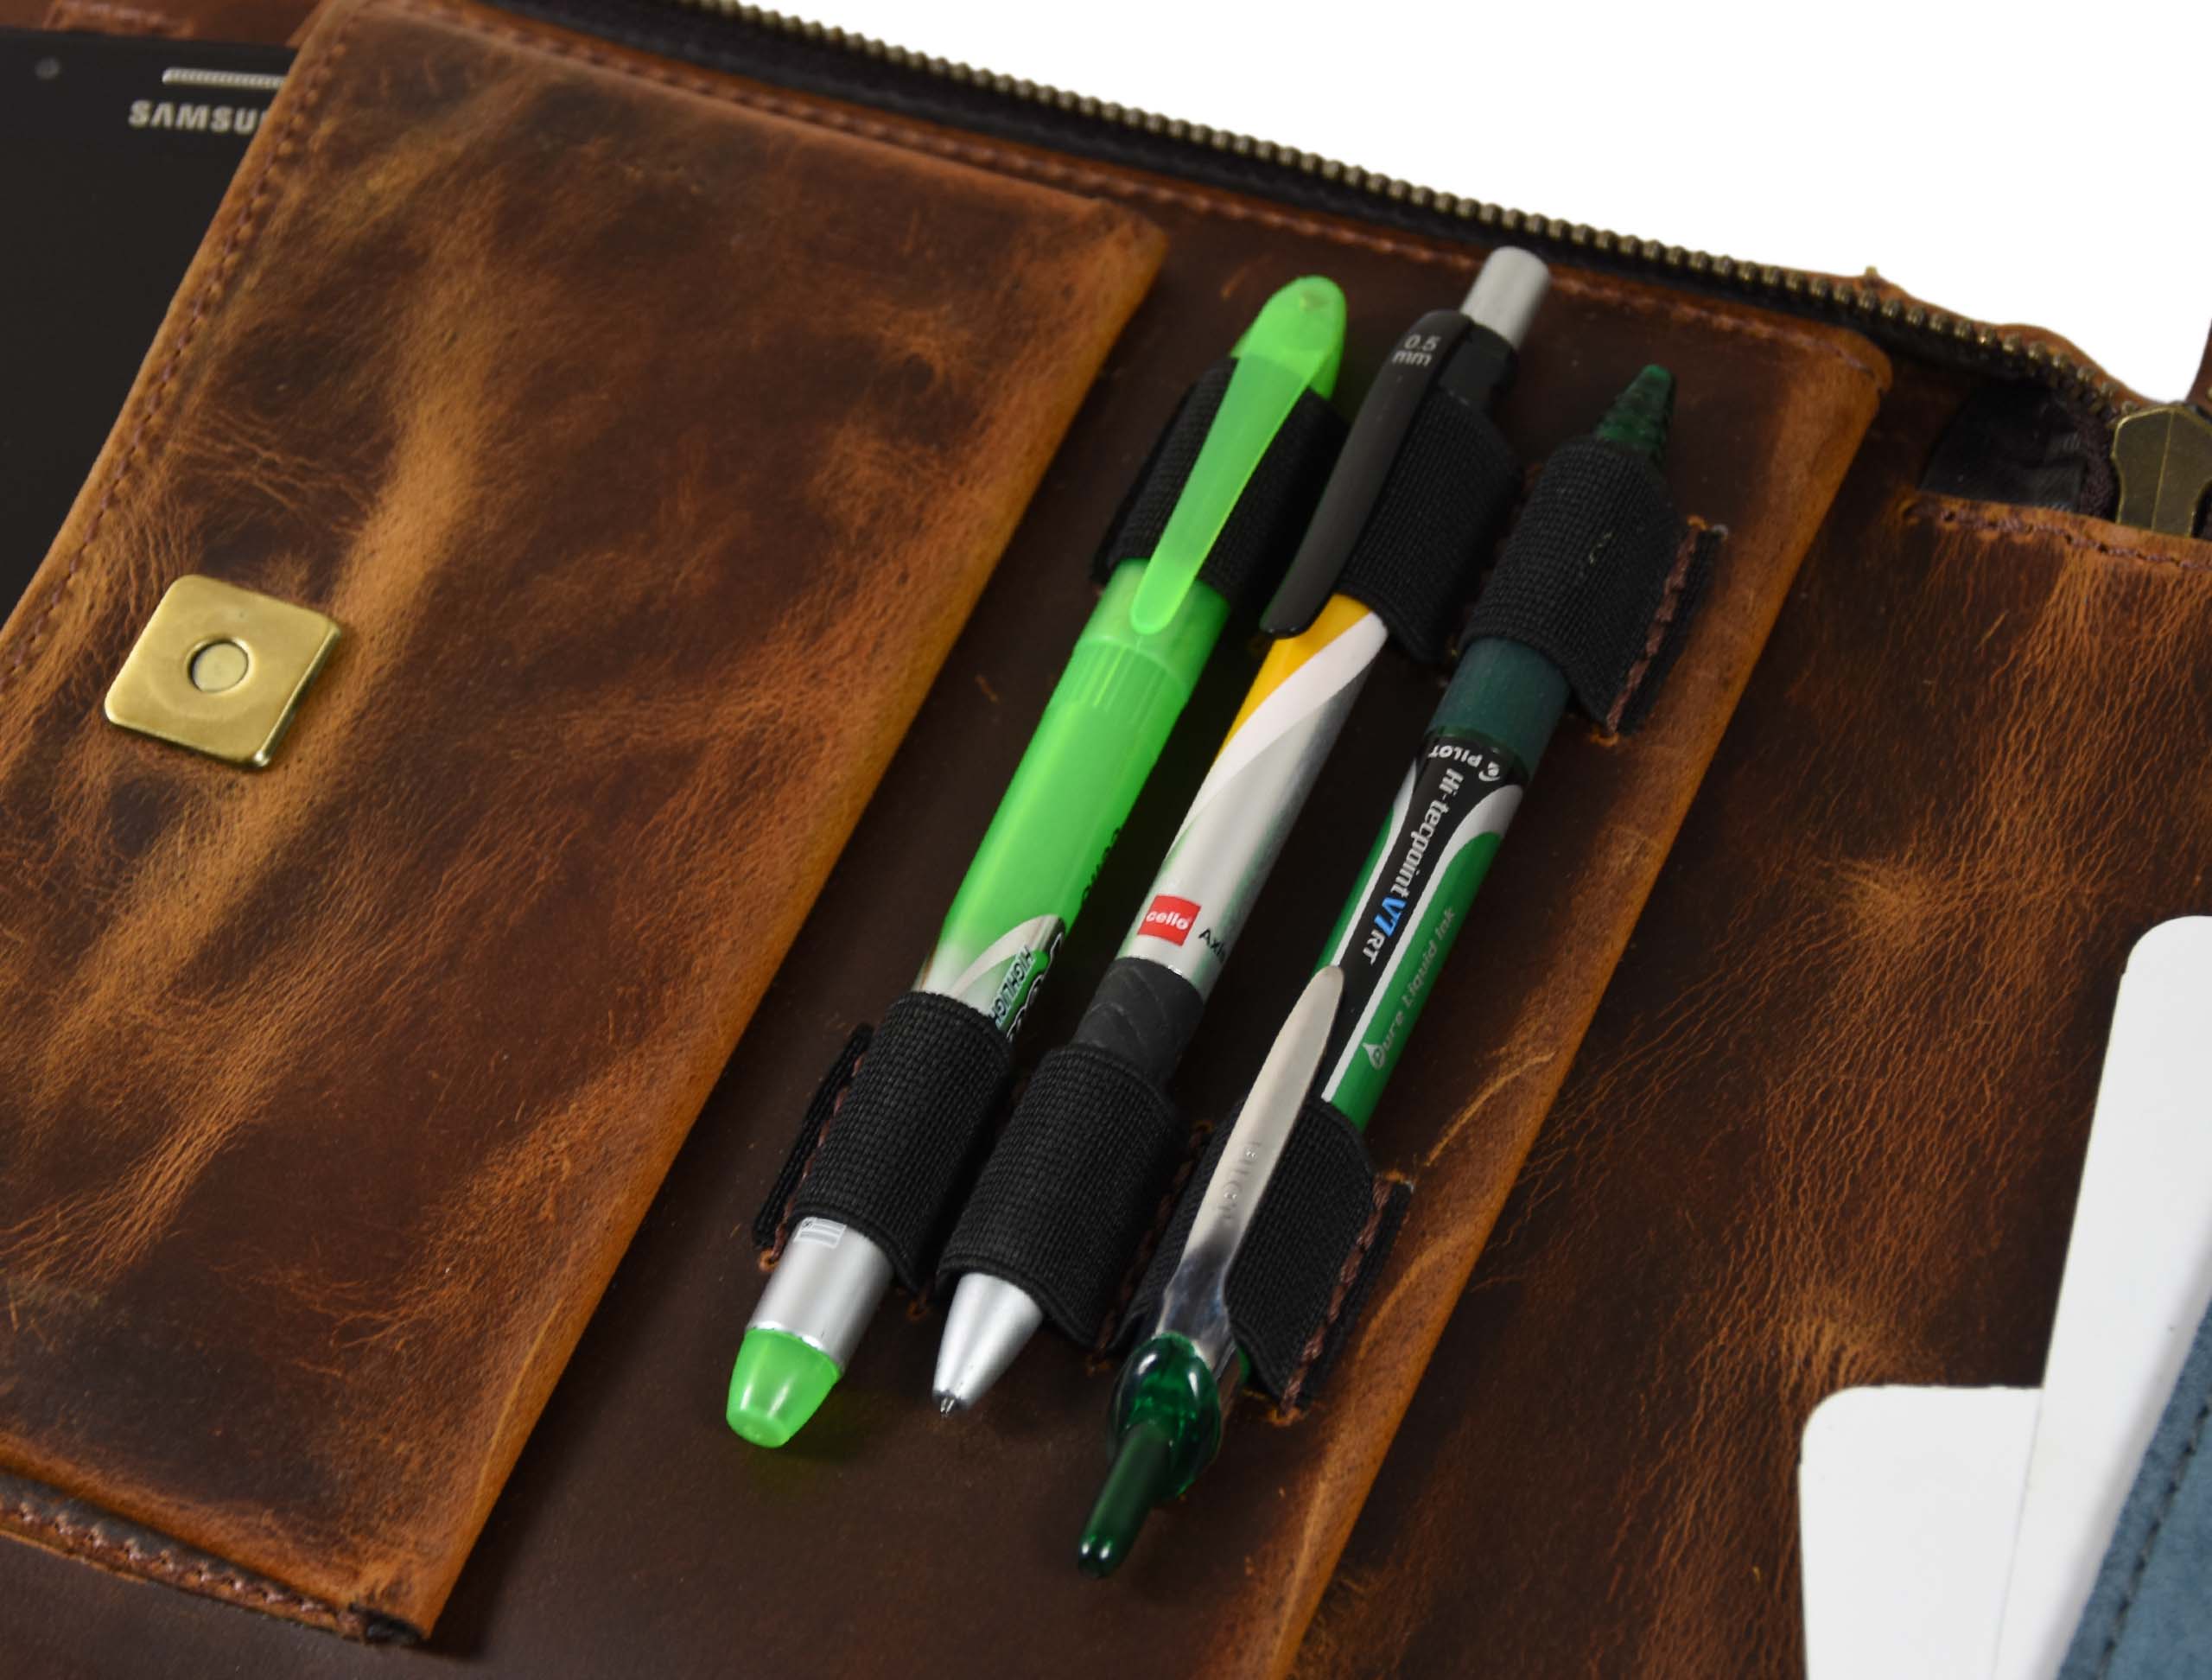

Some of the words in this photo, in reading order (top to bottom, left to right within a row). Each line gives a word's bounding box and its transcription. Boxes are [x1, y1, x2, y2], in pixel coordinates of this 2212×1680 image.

[129, 99, 267, 135] SAMSU
[1405, 334, 1441, 352] 0.5
[1392, 350, 1433, 366] mm
[1427, 744, 1483, 767] PILOT
[1146, 911, 1189, 930] cello
[1402, 939, 1437, 1009] Liquid
